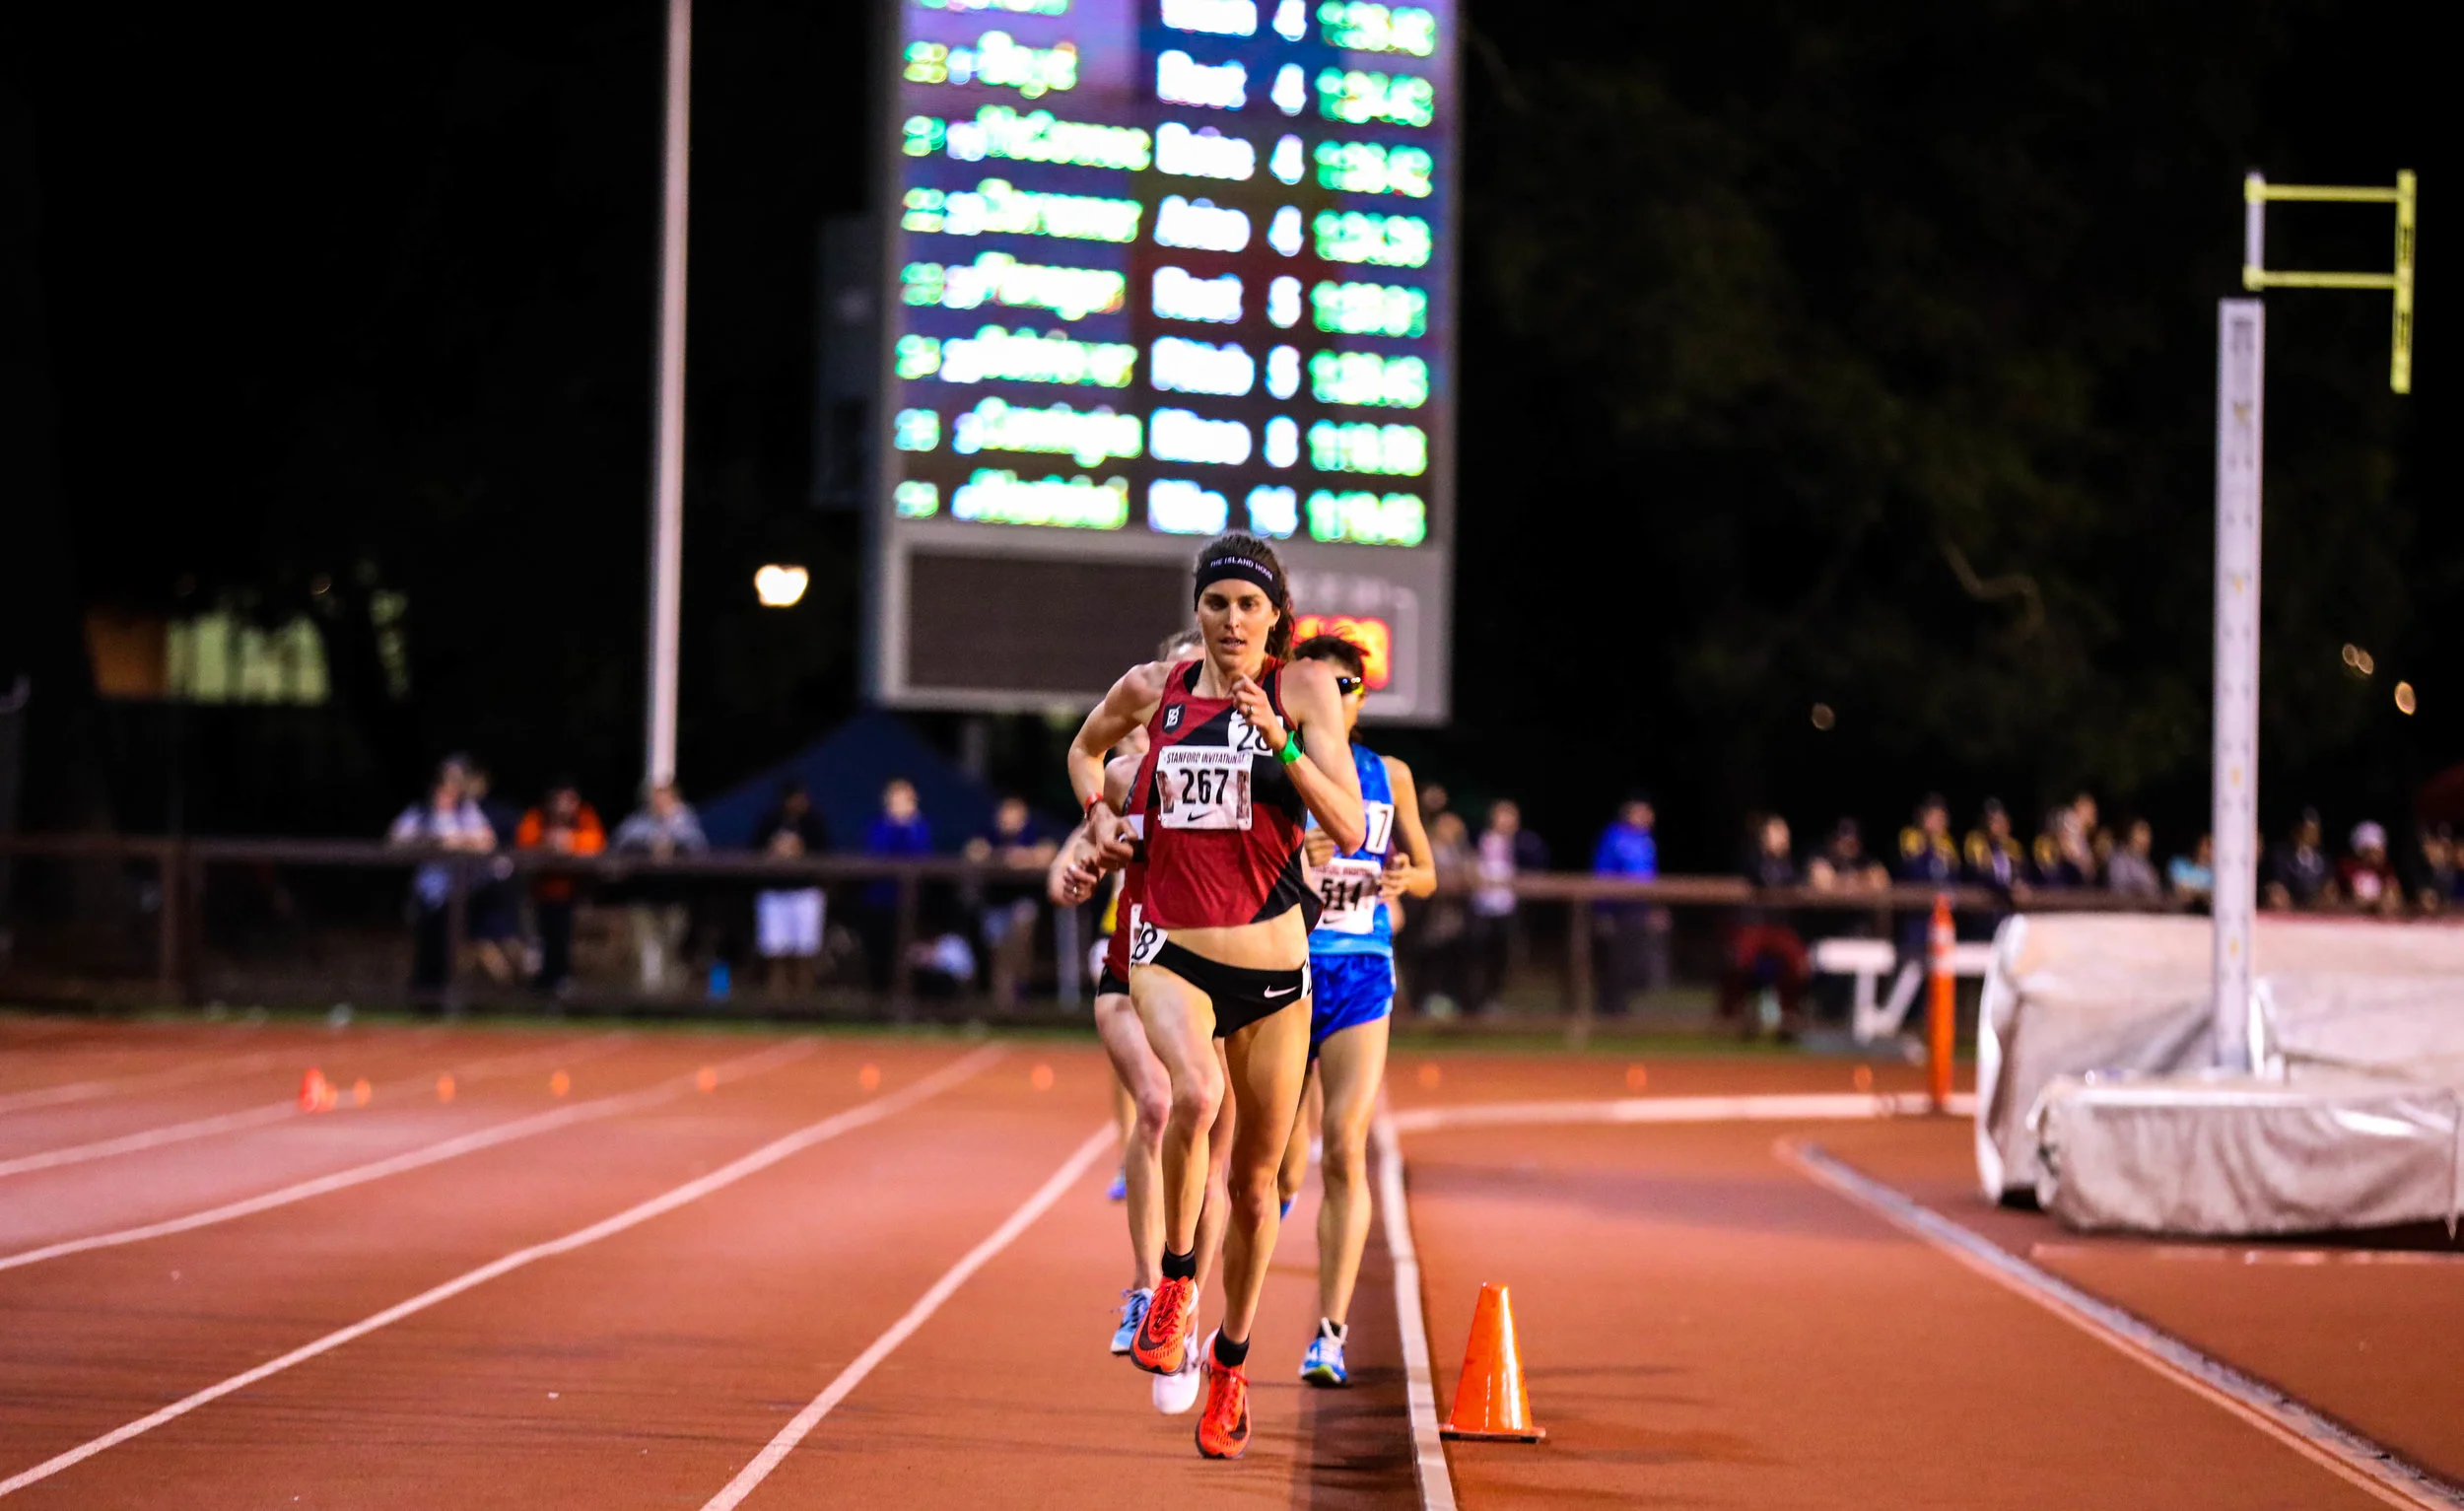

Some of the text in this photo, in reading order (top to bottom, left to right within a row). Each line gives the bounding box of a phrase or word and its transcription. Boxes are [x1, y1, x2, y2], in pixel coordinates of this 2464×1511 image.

[1210, 558, 1223, 569] THE
[1224, 556, 1254, 569] ISLAND
[1166, 751, 1200, 764] STANFORD
[1180, 769, 1229, 804] 267
